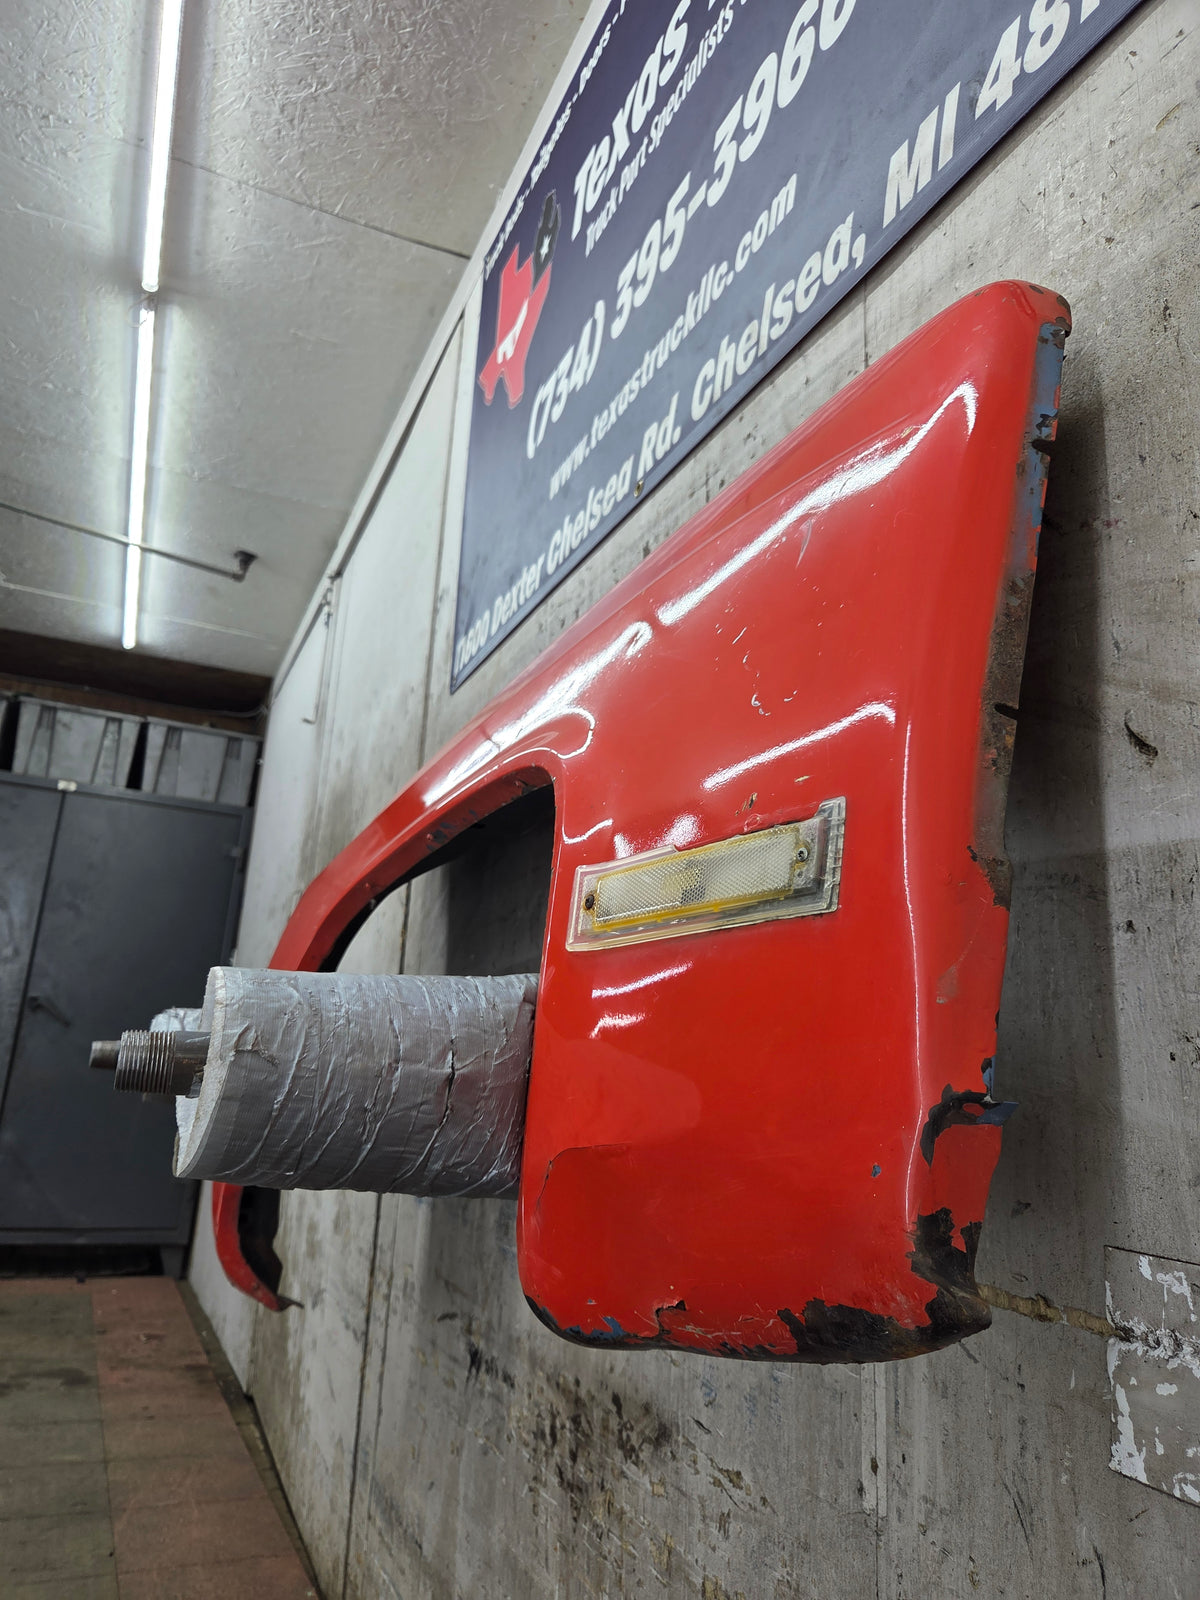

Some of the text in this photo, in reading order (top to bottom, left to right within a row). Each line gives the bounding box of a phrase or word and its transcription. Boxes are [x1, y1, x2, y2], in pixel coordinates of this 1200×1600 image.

[571, 0, 691, 242] Texas
[579, 23, 611, 96] Doors
[585, 0, 735, 258] Truck Part Specialists
[490, 553, 546, 636] Dexter
[547, 454, 635, 575] Chelsea
[637, 391, 682, 481] Rd.
[691, 211, 866, 421] Chelsea,
[882, 81, 961, 229] MI
[975, 0, 1101, 121] 48
[527, 299, 605, 459] (734)
[550, 173, 797, 501] www.texastruckllc.com
